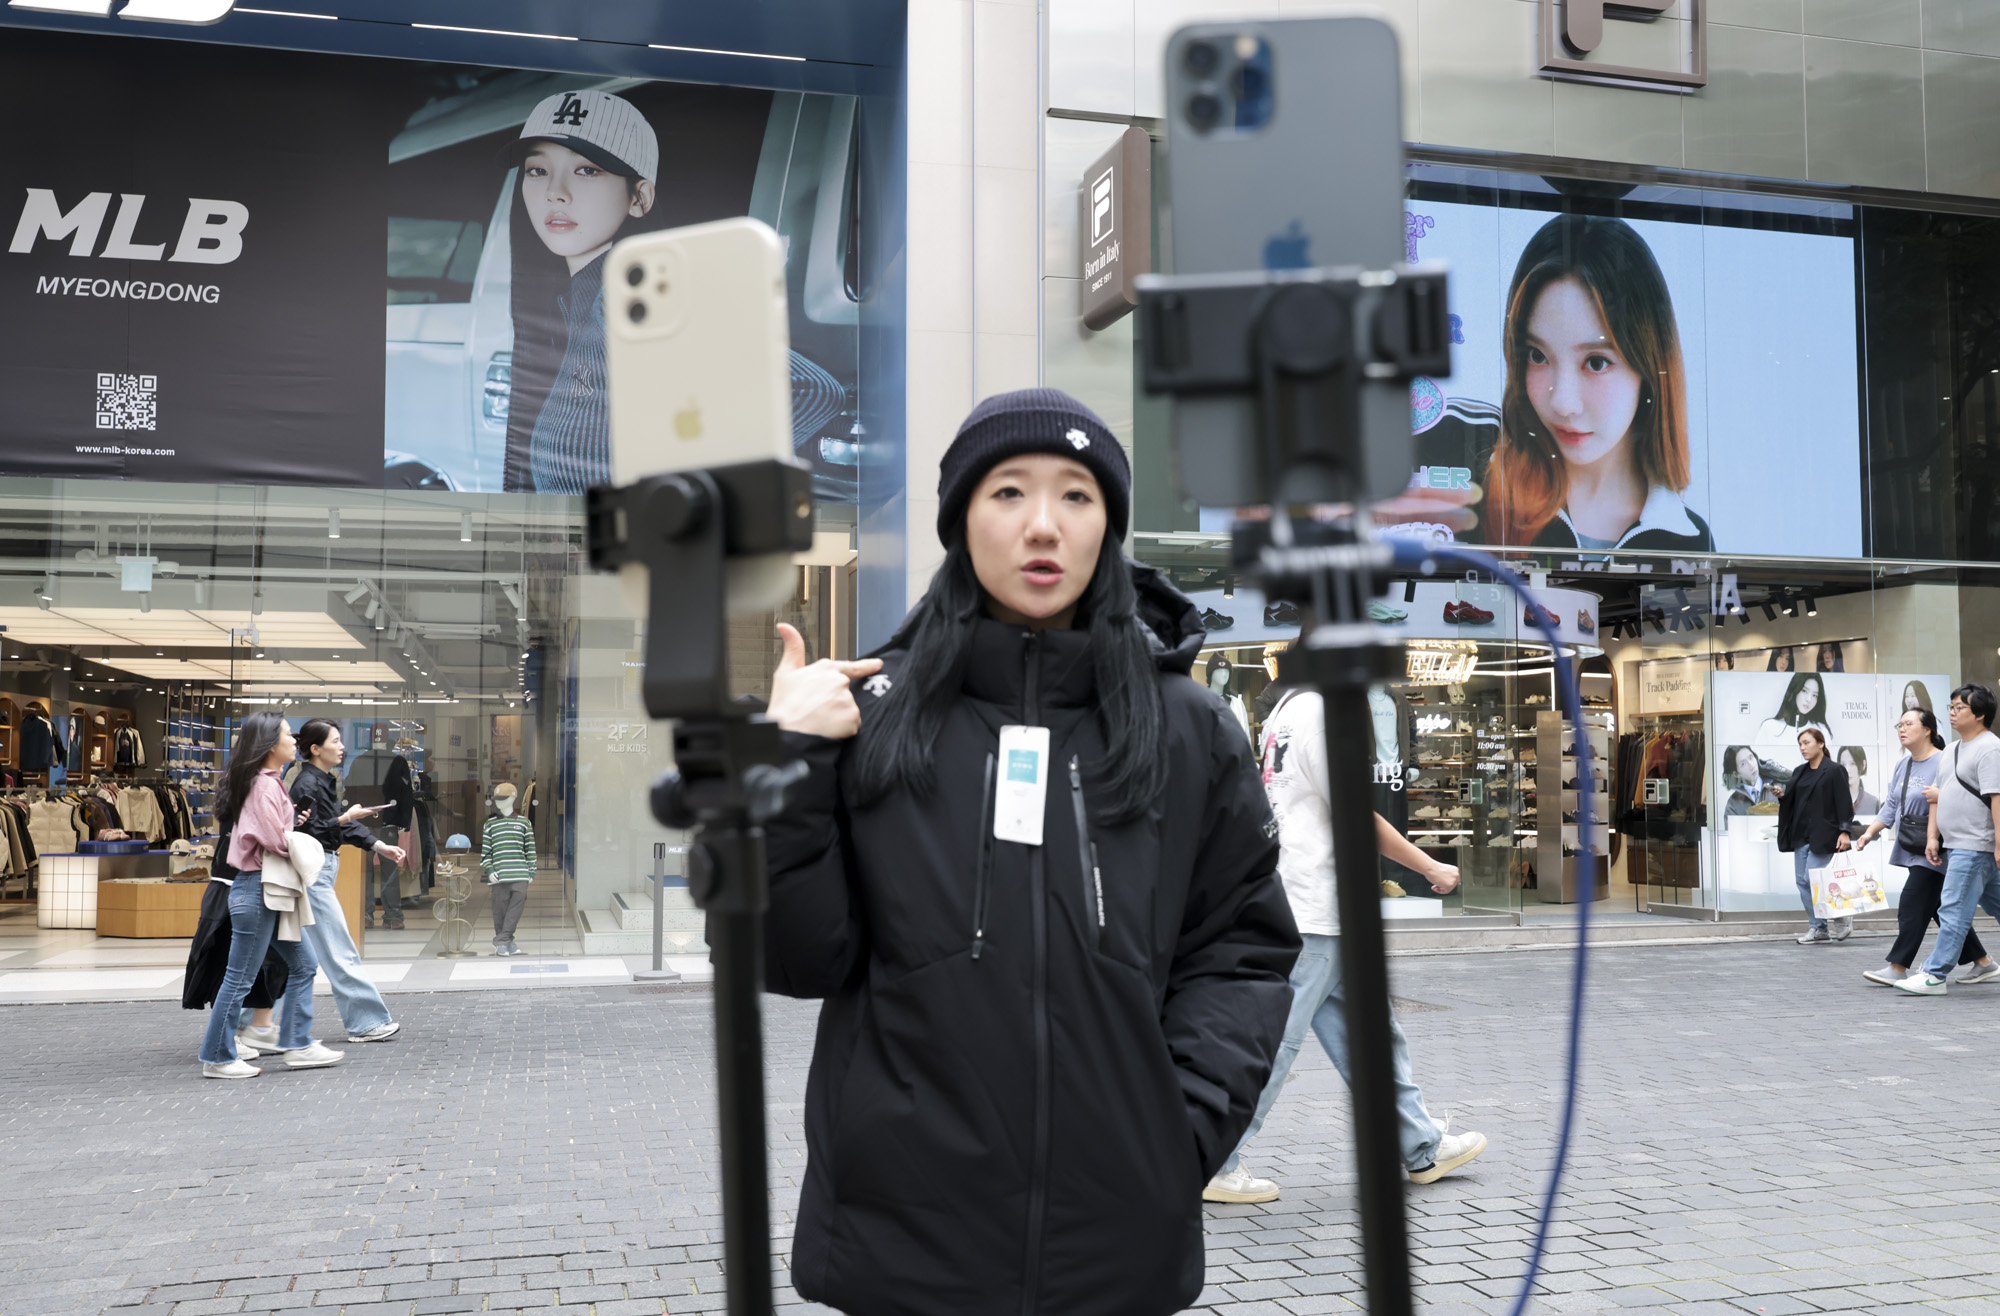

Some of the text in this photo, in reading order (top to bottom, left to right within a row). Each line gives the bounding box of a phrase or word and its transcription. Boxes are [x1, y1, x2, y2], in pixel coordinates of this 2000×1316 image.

[8, 188, 249, 264] MLB
[1085, 240, 1119, 280] Born in Italy
[1092, 272, 1112, 292] SINCE 1911
[36, 276, 220, 303] MYEONGDONG
[75, 445, 175, 456] www.mlb-korea.com
[1646, 681, 1664, 693] Track
[1844, 701, 1868, 710] TRACK
[1841, 711, 1872, 720] PADDING
[608, 724, 629, 740] 2F
[607, 743, 647, 753] MLB KIDS
